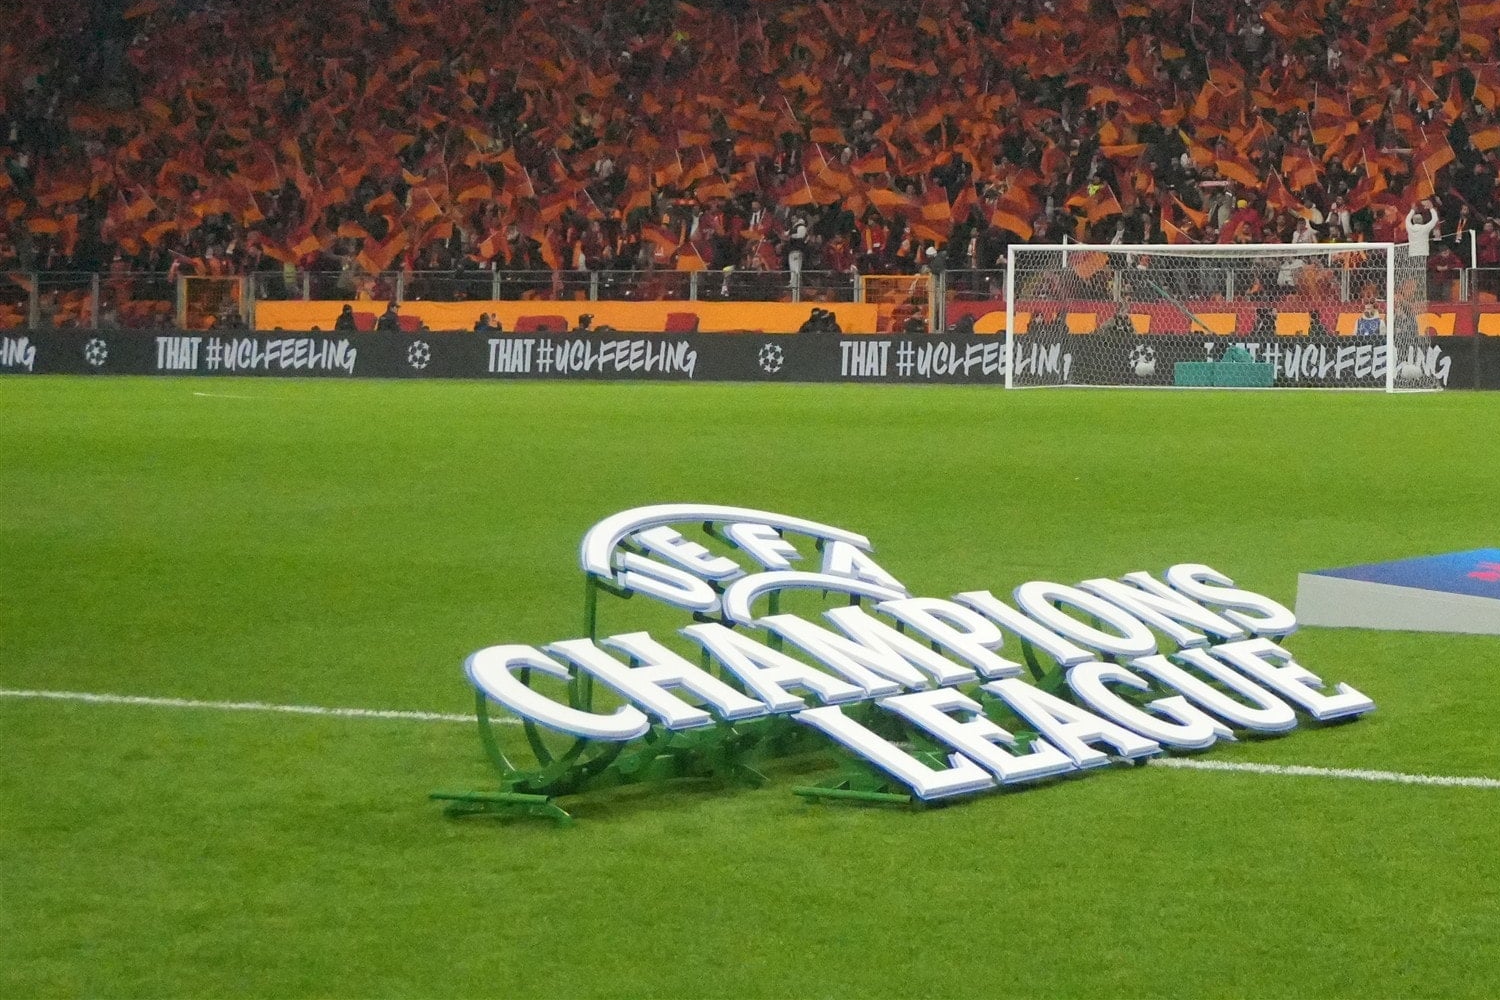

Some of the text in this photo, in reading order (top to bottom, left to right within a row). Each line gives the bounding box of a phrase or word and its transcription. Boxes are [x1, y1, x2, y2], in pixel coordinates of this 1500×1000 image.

[156, 336, 357, 374] THAT #UCLFEELING
[487, 338, 698, 379] THAT #UCLFEELING
[839, 340, 892, 377] THAT
[612, 522, 910, 613] UEFA
[464, 561, 1299, 741] CHAMPIONS
[799, 637, 1378, 801] LEAGUE
